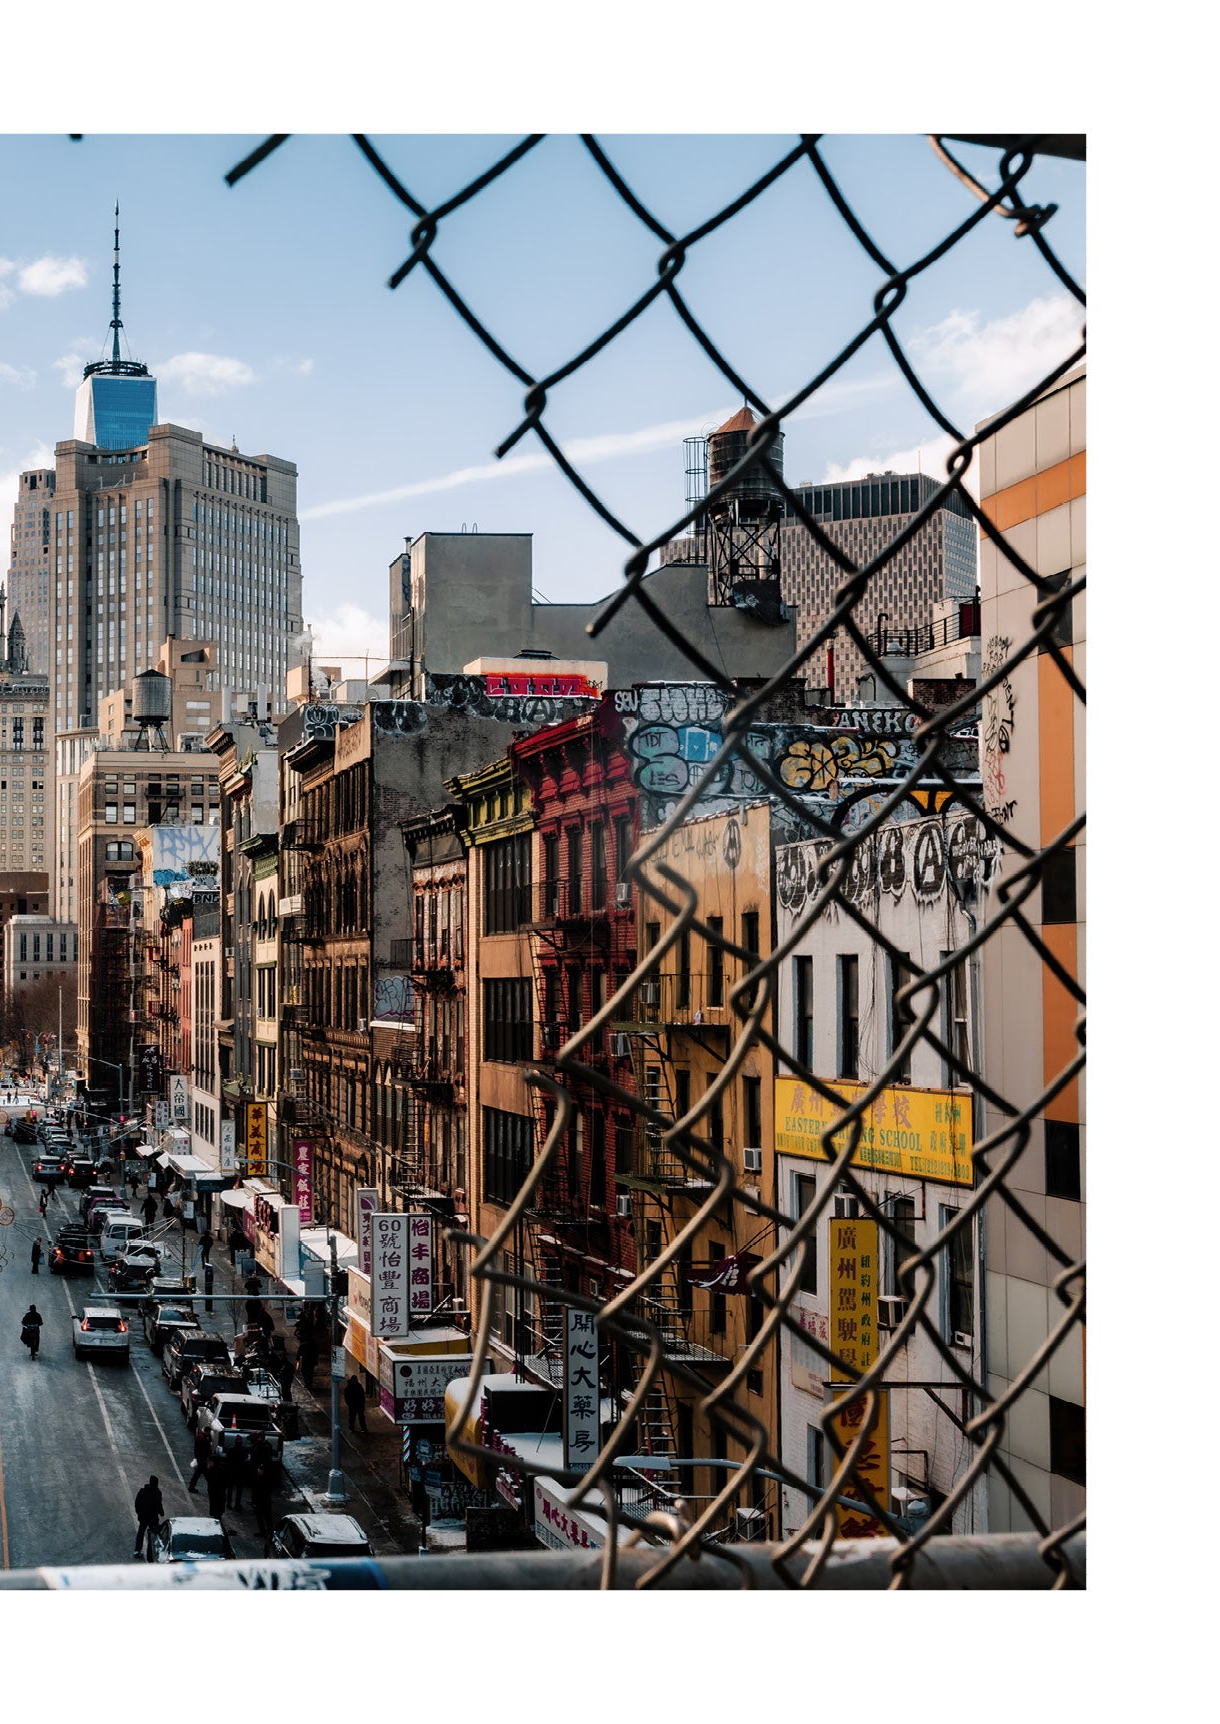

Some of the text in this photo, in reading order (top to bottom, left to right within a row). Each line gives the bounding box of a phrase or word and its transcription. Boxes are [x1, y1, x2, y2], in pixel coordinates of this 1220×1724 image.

[989, 651, 1004, 666] FOR
[790, 1084, 912, 1129] 廣州學校
[879, 1128, 922, 1152] SCHOOL
[837, 1227, 857, 1382] 廣州駕駛學
[860, 1254, 871, 1367] 紐約州政府註
[570, 1314, 596, 1453] 開心大藥房
